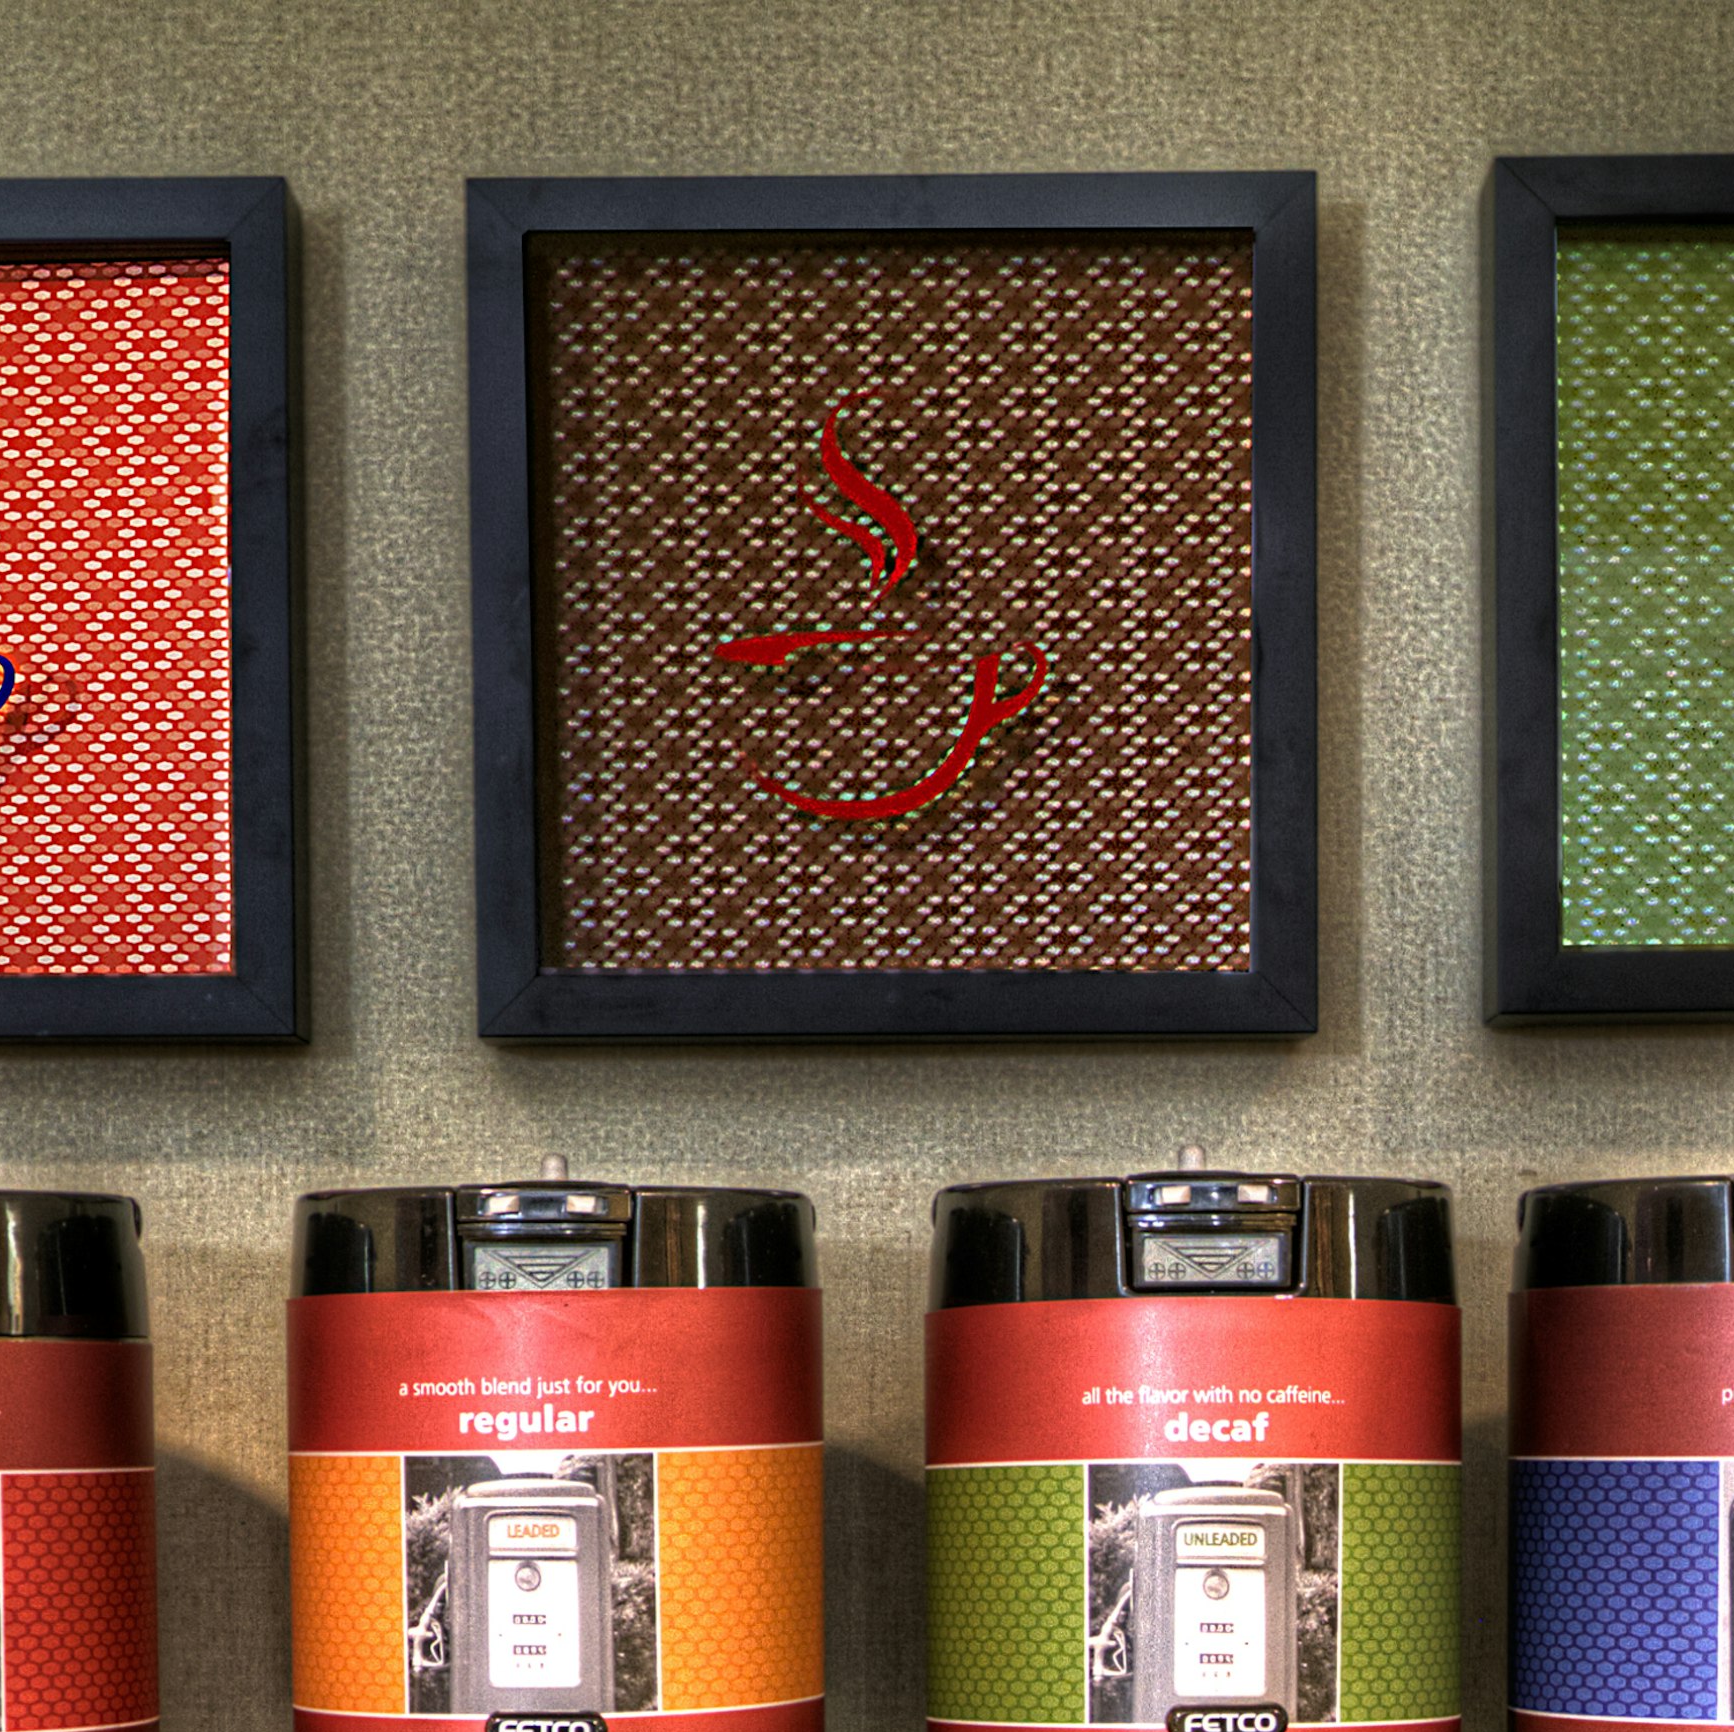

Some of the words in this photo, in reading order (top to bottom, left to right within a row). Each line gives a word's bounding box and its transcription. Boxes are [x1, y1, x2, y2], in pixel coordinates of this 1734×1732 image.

[399, 1383, 408, 1396] a
[413, 1378, 475, 1396] smooth
[481, 1377, 531, 1395] blend
[536, 1377, 569, 1399] just
[576, 1376, 602, 1394] for
[608, 1380, 657, 1398] you...
[1082, 1387, 1100, 1405] all
[1105, 1387, 1133, 1404] the
[1139, 1385, 1188, 1404] flavor
[1193, 1385, 1233, 1403] with
[1239, 1389, 1261, 1403] no
[1267, 1385, 1344, 1404] caffeine...
[459, 1404, 594, 1440] regular
[1164, 1412, 1269, 1441] decaf
[507, 1524, 560, 1538] LEADED
[1184, 1533, 1258, 1546] UNLEADED
